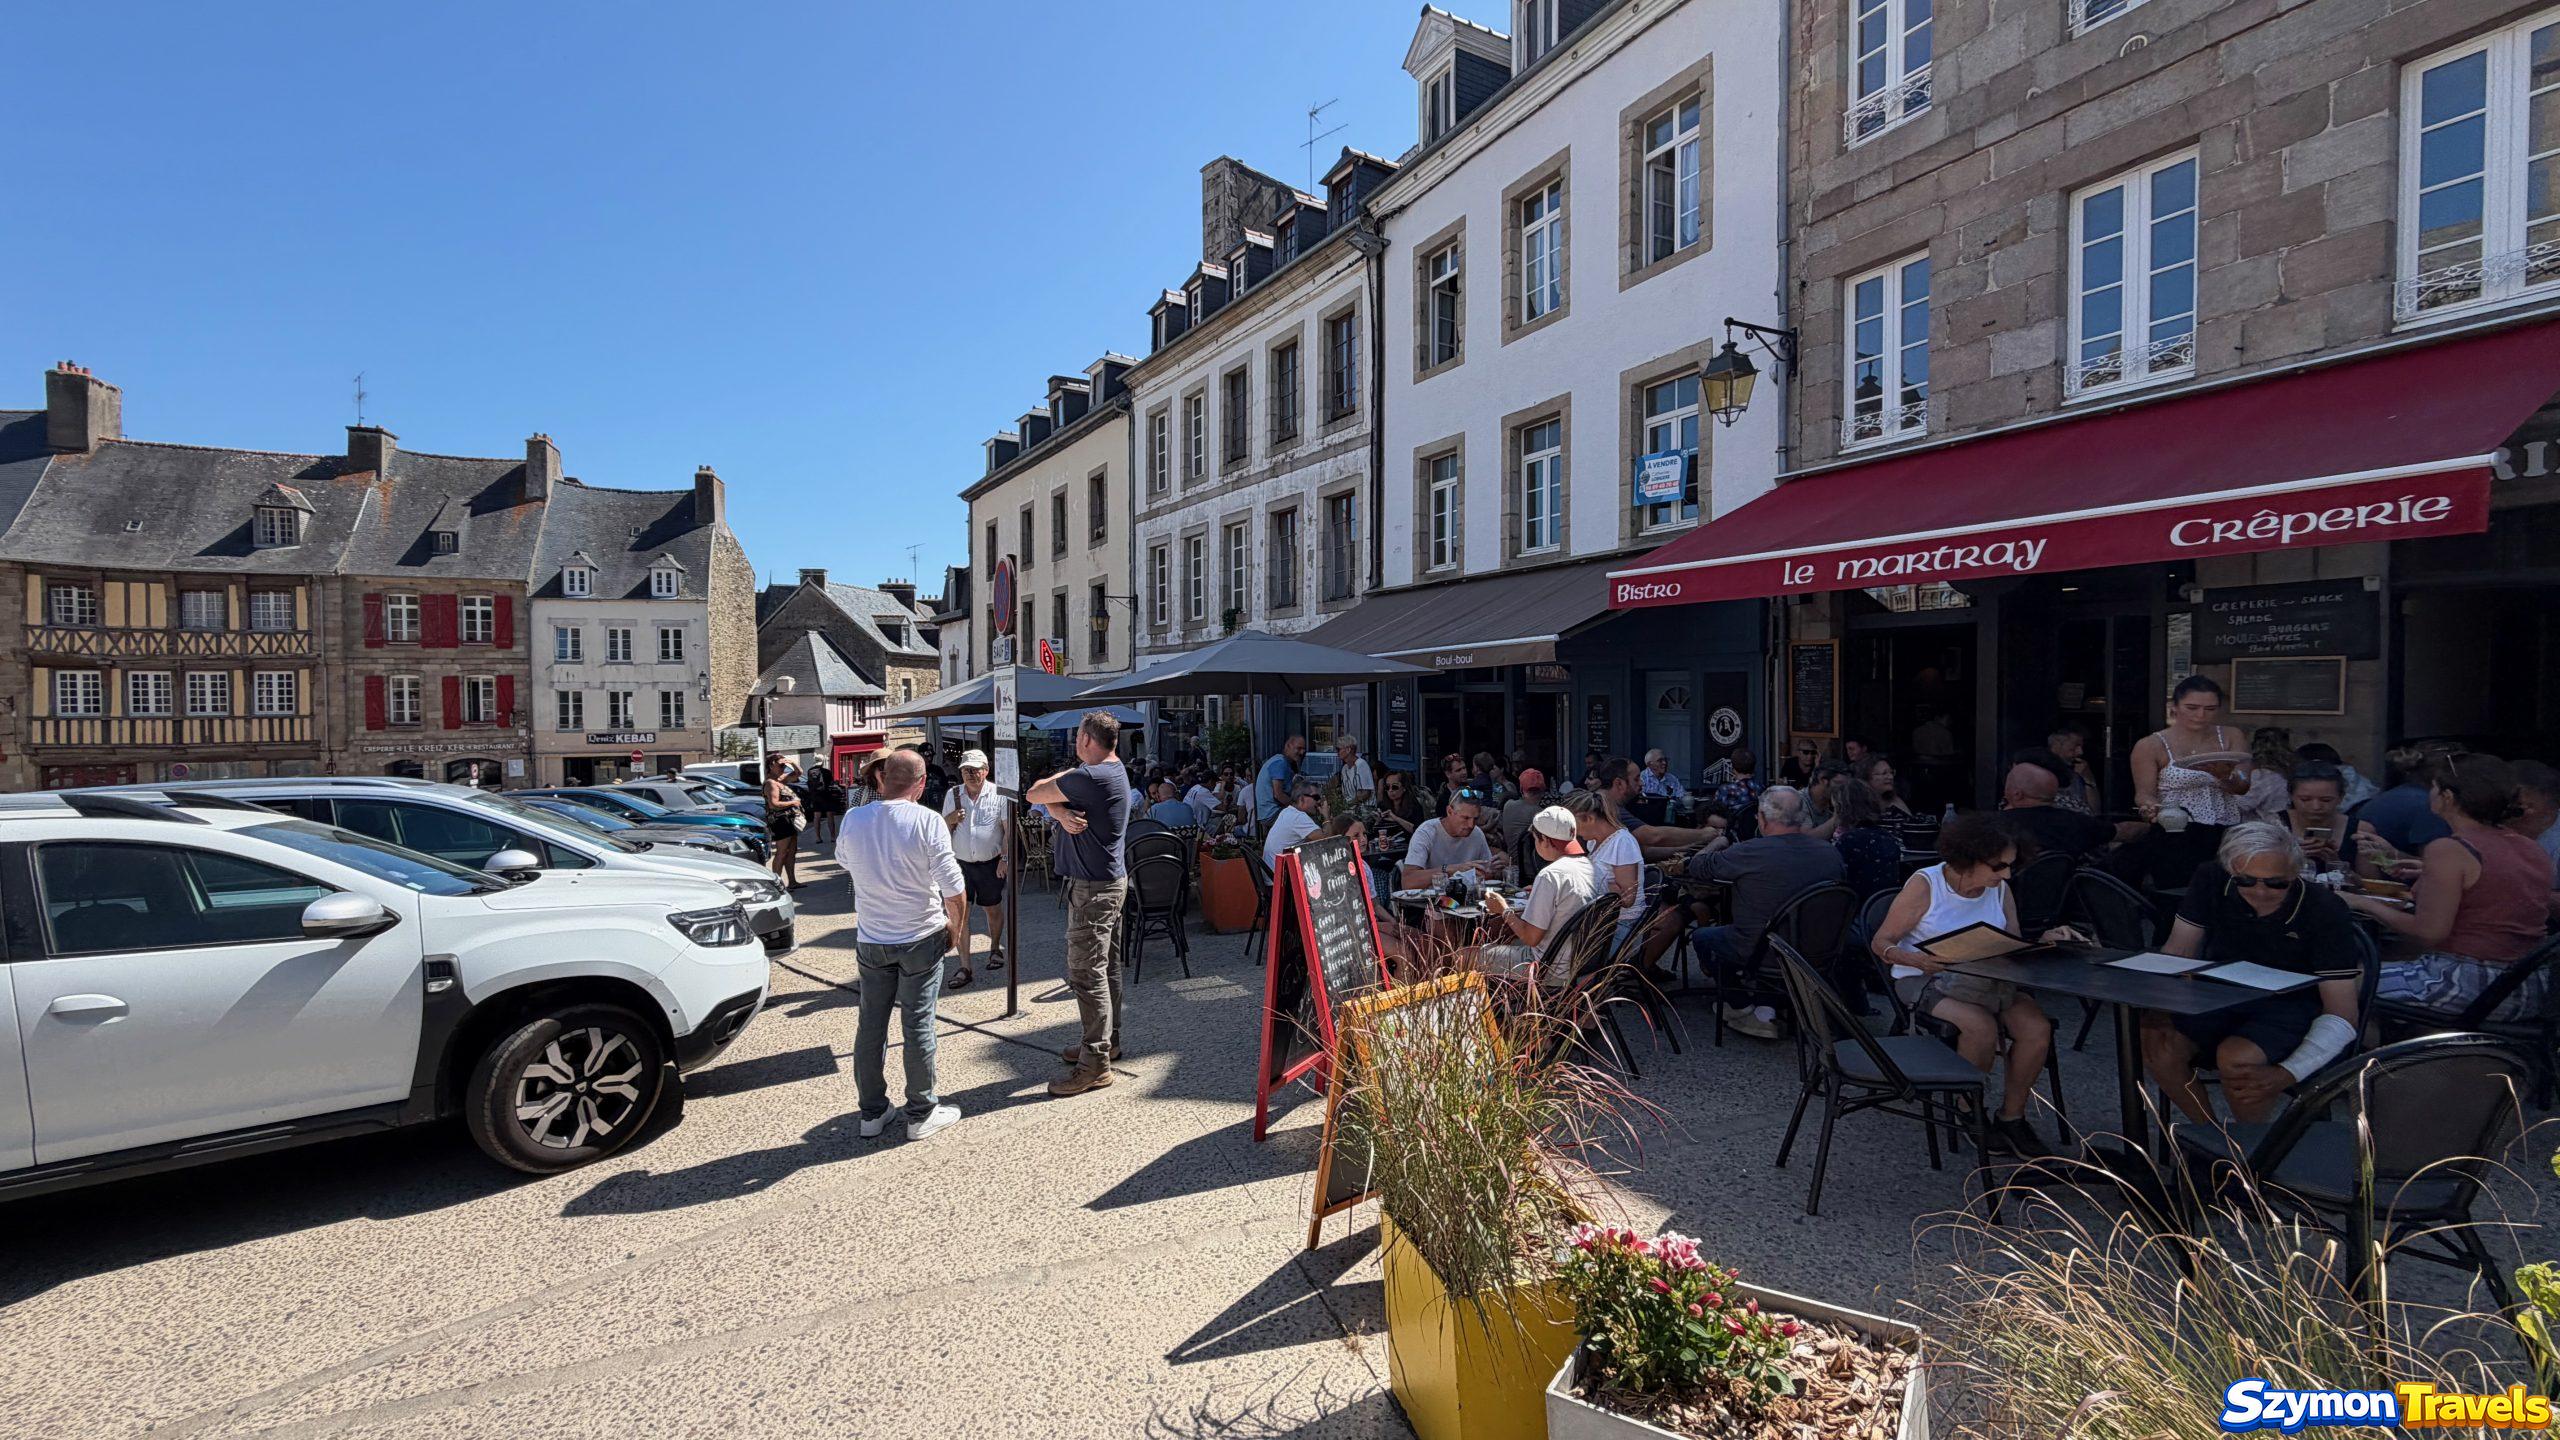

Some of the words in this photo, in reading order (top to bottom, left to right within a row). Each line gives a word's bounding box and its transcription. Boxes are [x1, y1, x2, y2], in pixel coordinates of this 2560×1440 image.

[1653, 459, 1678, 469] VENDRE
[2169, 494, 2454, 547] Crêperie
[1617, 583, 1681, 603] Bistro
[2212, 599, 2278, 612] CREPERIE
[2301, 594, 2344, 605] SNACK
[2268, 622, 2331, 635] BURGERS
[1043, 647, 1053, 672] TABAC
[615, 733, 655, 743] KEBAB
[403, 744, 415, 753] LE
[418, 744, 444, 752] KREIZ
